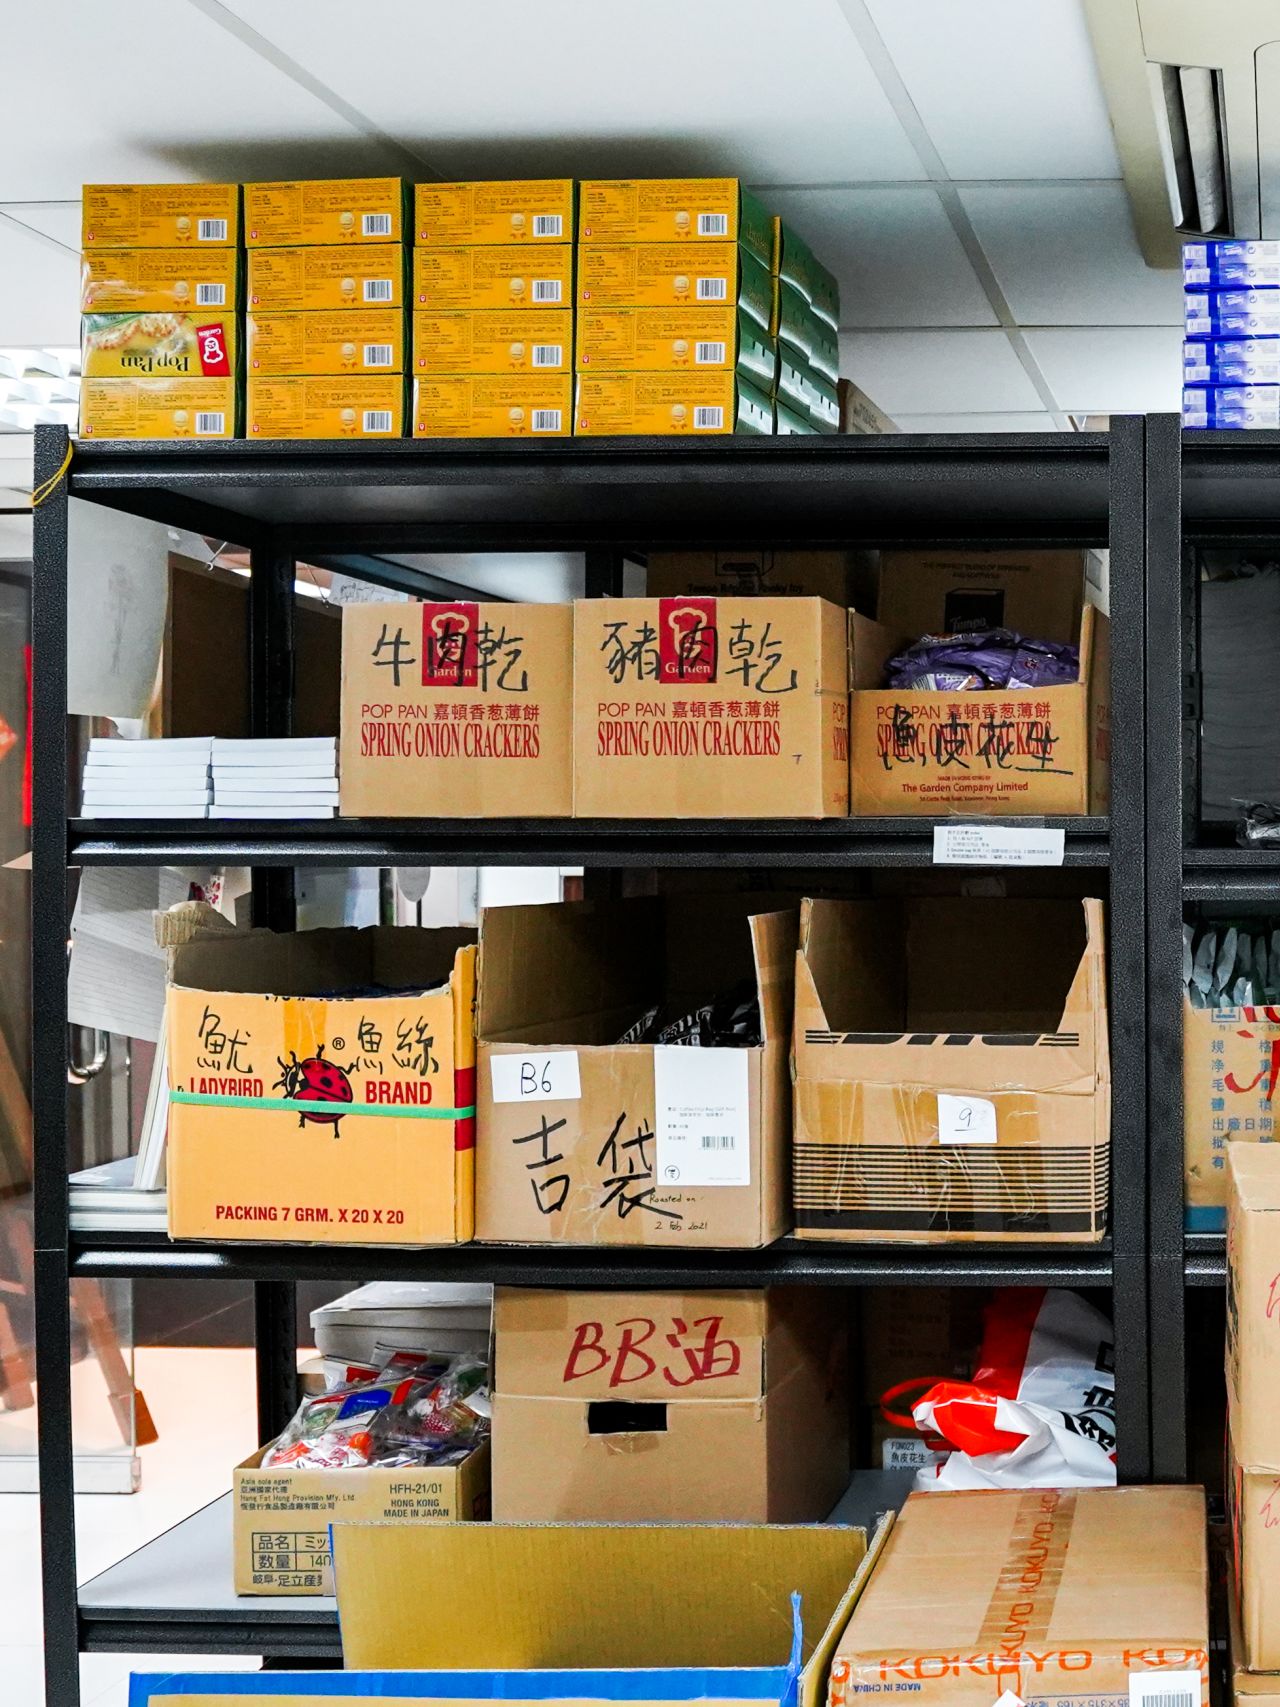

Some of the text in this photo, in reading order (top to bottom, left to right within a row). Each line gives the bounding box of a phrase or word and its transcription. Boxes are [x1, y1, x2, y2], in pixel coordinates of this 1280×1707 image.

[121, 353, 189, 371] Pop Pan
[372, 623, 528, 692] 牛肉乾
[600, 618, 798, 693] 豬肉乾
[361, 703, 540, 721] POP PAN 嘉頓香葱薄餅
[598, 701, 781, 718] POP PAN 嘉頓香葱薄餅
[911, 705, 941, 720] PAN
[361, 722, 540, 758] SPRING ONION CRACKERS
[598, 720, 781, 757] SPRING ONION CRACKERS
[902, 782, 1029, 795] The Garden Company Limited
[520, 1060, 552, 1096] B6
[365, 1080, 432, 1105] BRAND
[216, 1205, 404, 1224] PACKING 7 GRM. X 20 X 20
[654, 1220, 663, 1230] 2
[687, 1221, 709, 1231] 2021
[891, 1452, 927, 1464] 魚皮花生
[273, 1478, 292, 1486] agent
[389, 1483, 443, 1495] HFH-21/01
[391, 1499, 440, 1508] HONG KONG
[384, 1508, 449, 1518] MADE IN JAPAN
[258, 1535, 290, 1550] 品名
[258, 1554, 291, 1569] 数量
[883, 1684, 894, 1692] IN
[895, 1683, 921, 1692] MADE
